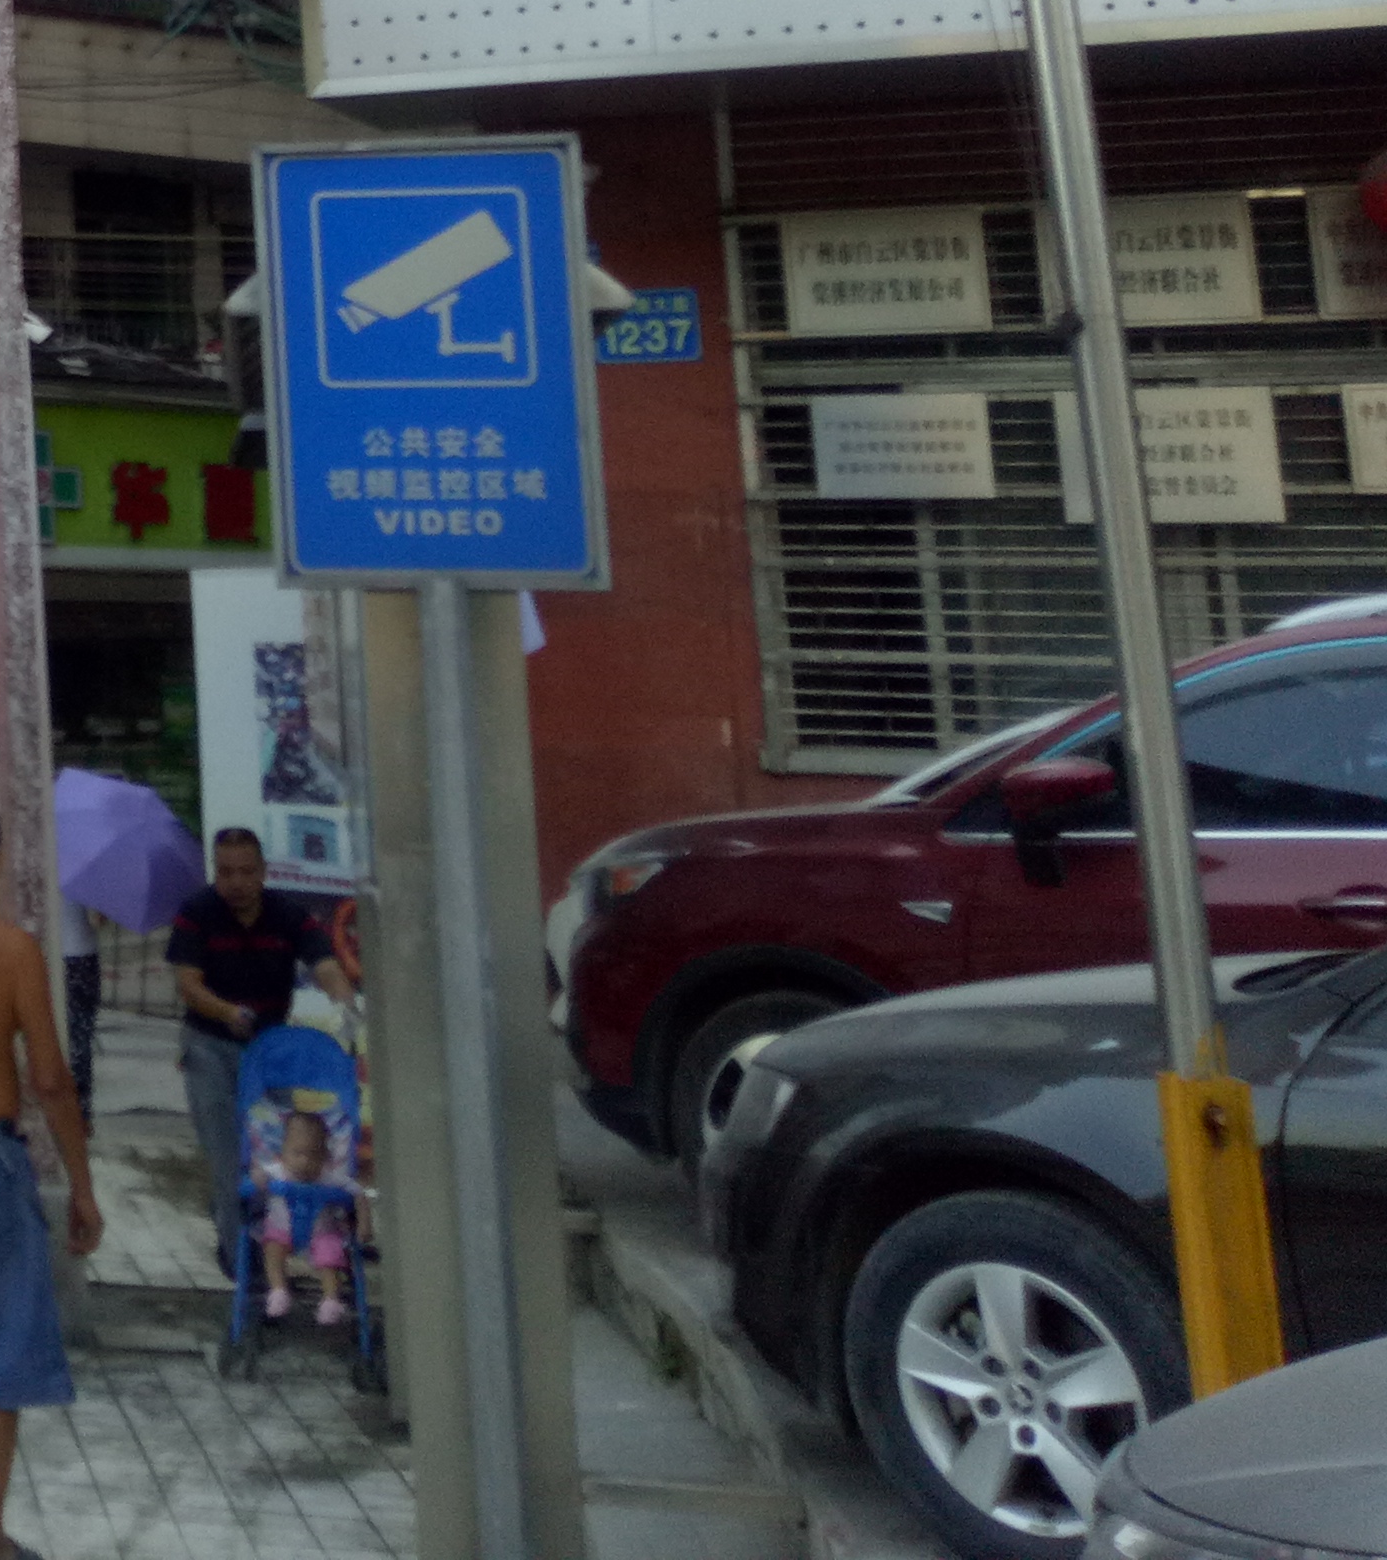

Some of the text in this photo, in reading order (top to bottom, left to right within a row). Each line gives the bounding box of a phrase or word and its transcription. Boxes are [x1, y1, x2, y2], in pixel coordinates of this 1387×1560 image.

[604, 318, 692, 355] 1237
[363, 425, 506, 459] 公共安全
[327, 467, 548, 501] 视频监控区域
[374, 508, 504, 536] VIDEO
